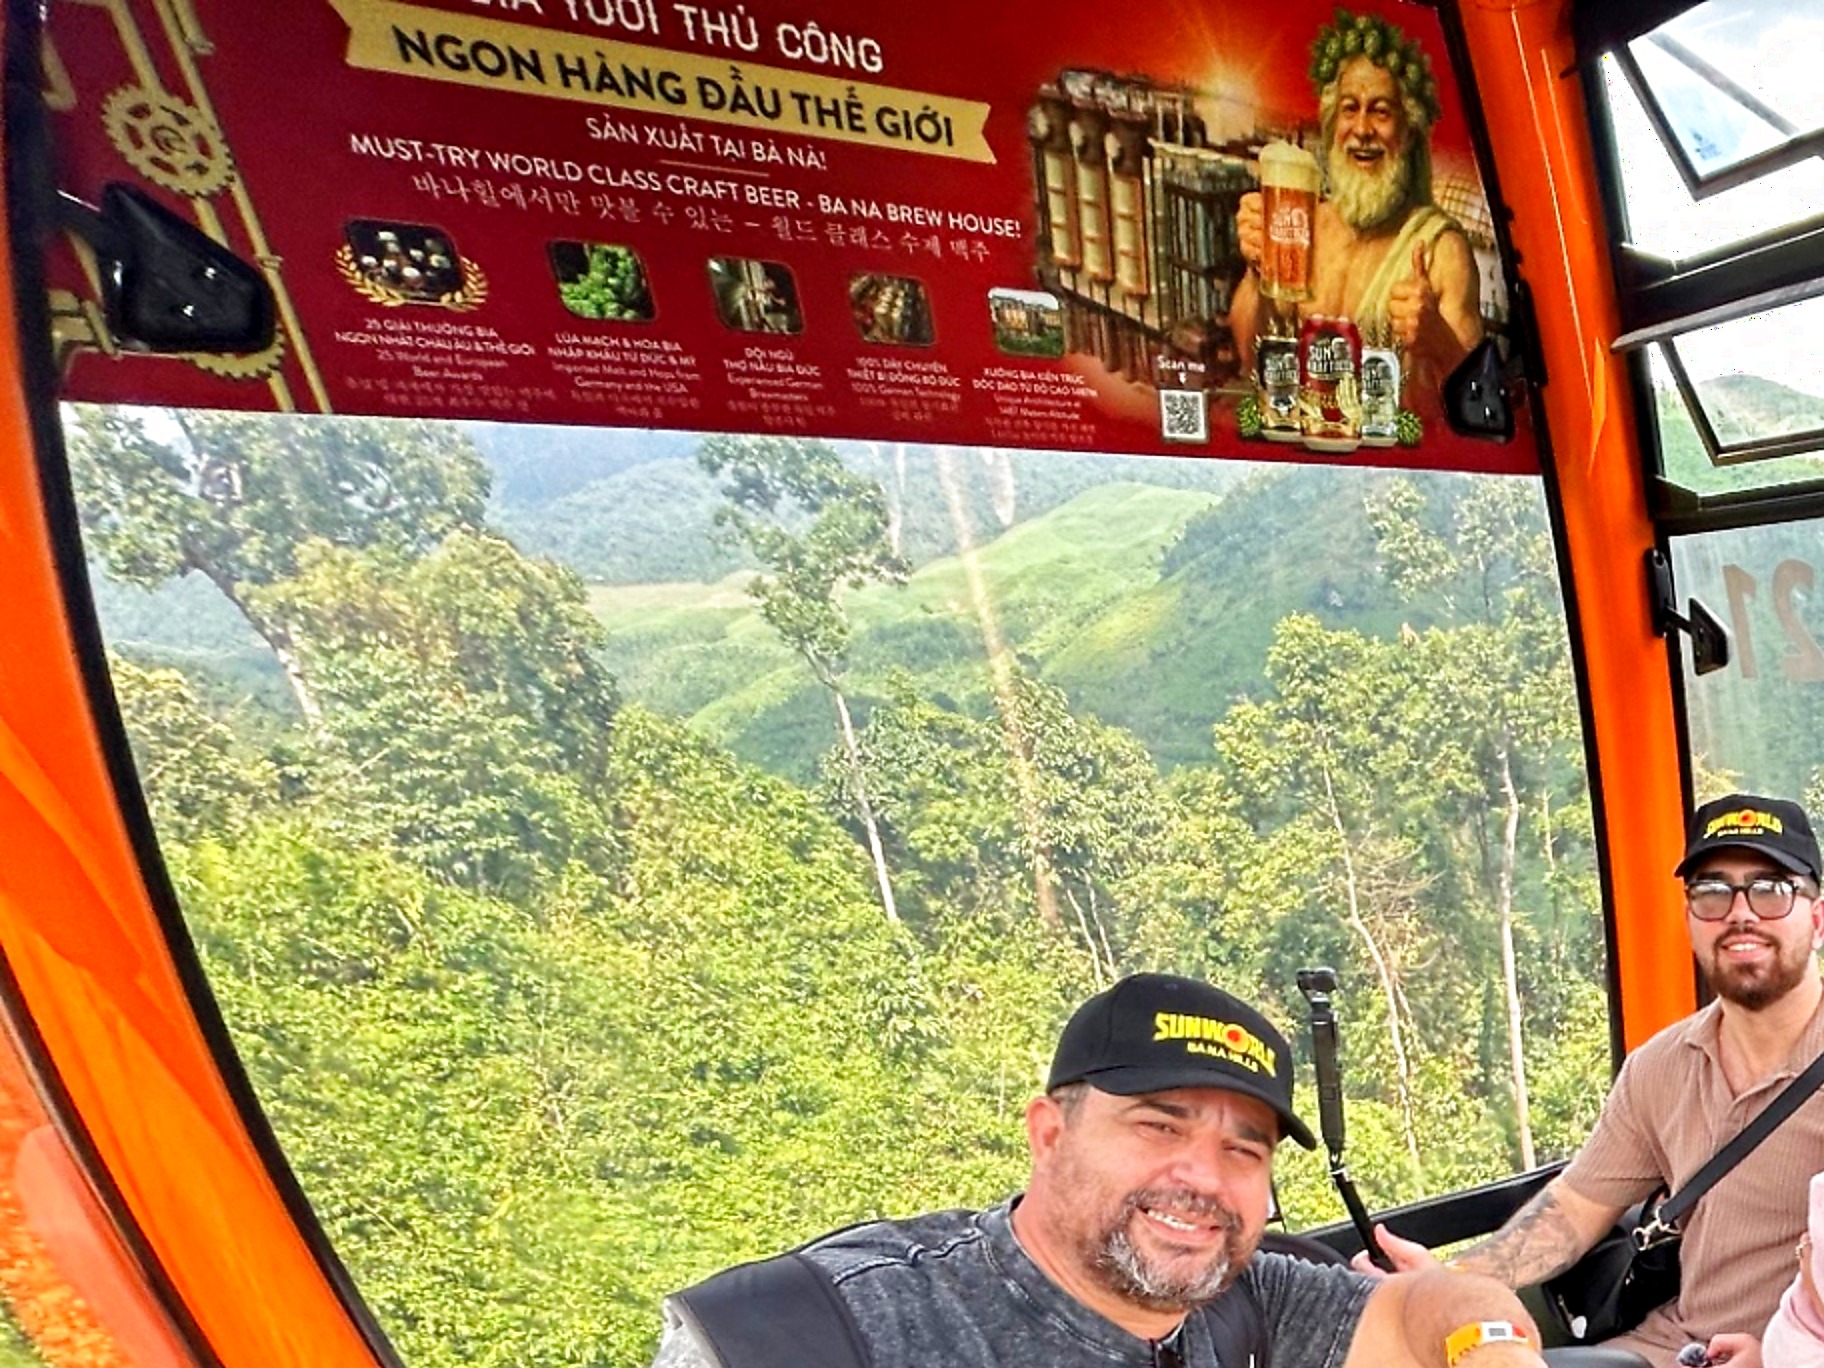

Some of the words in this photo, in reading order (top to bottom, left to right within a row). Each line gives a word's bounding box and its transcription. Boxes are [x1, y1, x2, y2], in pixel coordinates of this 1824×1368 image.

[673, 3, 759, 51] THỦ
[777, 22, 884, 72] CÔNG
[392, 25, 546, 84] NGON
[555, 51, 687, 105] HÀNG
[697, 65, 782, 120] ĐẦU
[790, 86, 867, 133] THẾ
[876, 105, 953, 147] GIỚI
[586, 113, 639, 144] SẢN
[643, 122, 704, 153] XUẤT
[709, 134, 746, 162] TẠI
[752, 139, 784, 165] BÀ
[351, 133, 480, 169] MUST-TRY
[486, 150, 582, 182] WORLD
[588, 164, 661, 192] CLASS
[666, 174, 739, 201] CRAFT
[746, 184, 800, 209] BEER
[818, 194, 848, 216] BA
[852, 199, 883, 219] NA
[887, 202, 942, 228] BREW
[949, 212, 1021, 239] HOUSE!
[411, 174, 580, 216] 바나힐에서만
[652, 200, 675, 225] 수
[1157, 355, 1185, 371] Scan
[1187, 361, 1206, 373] me
